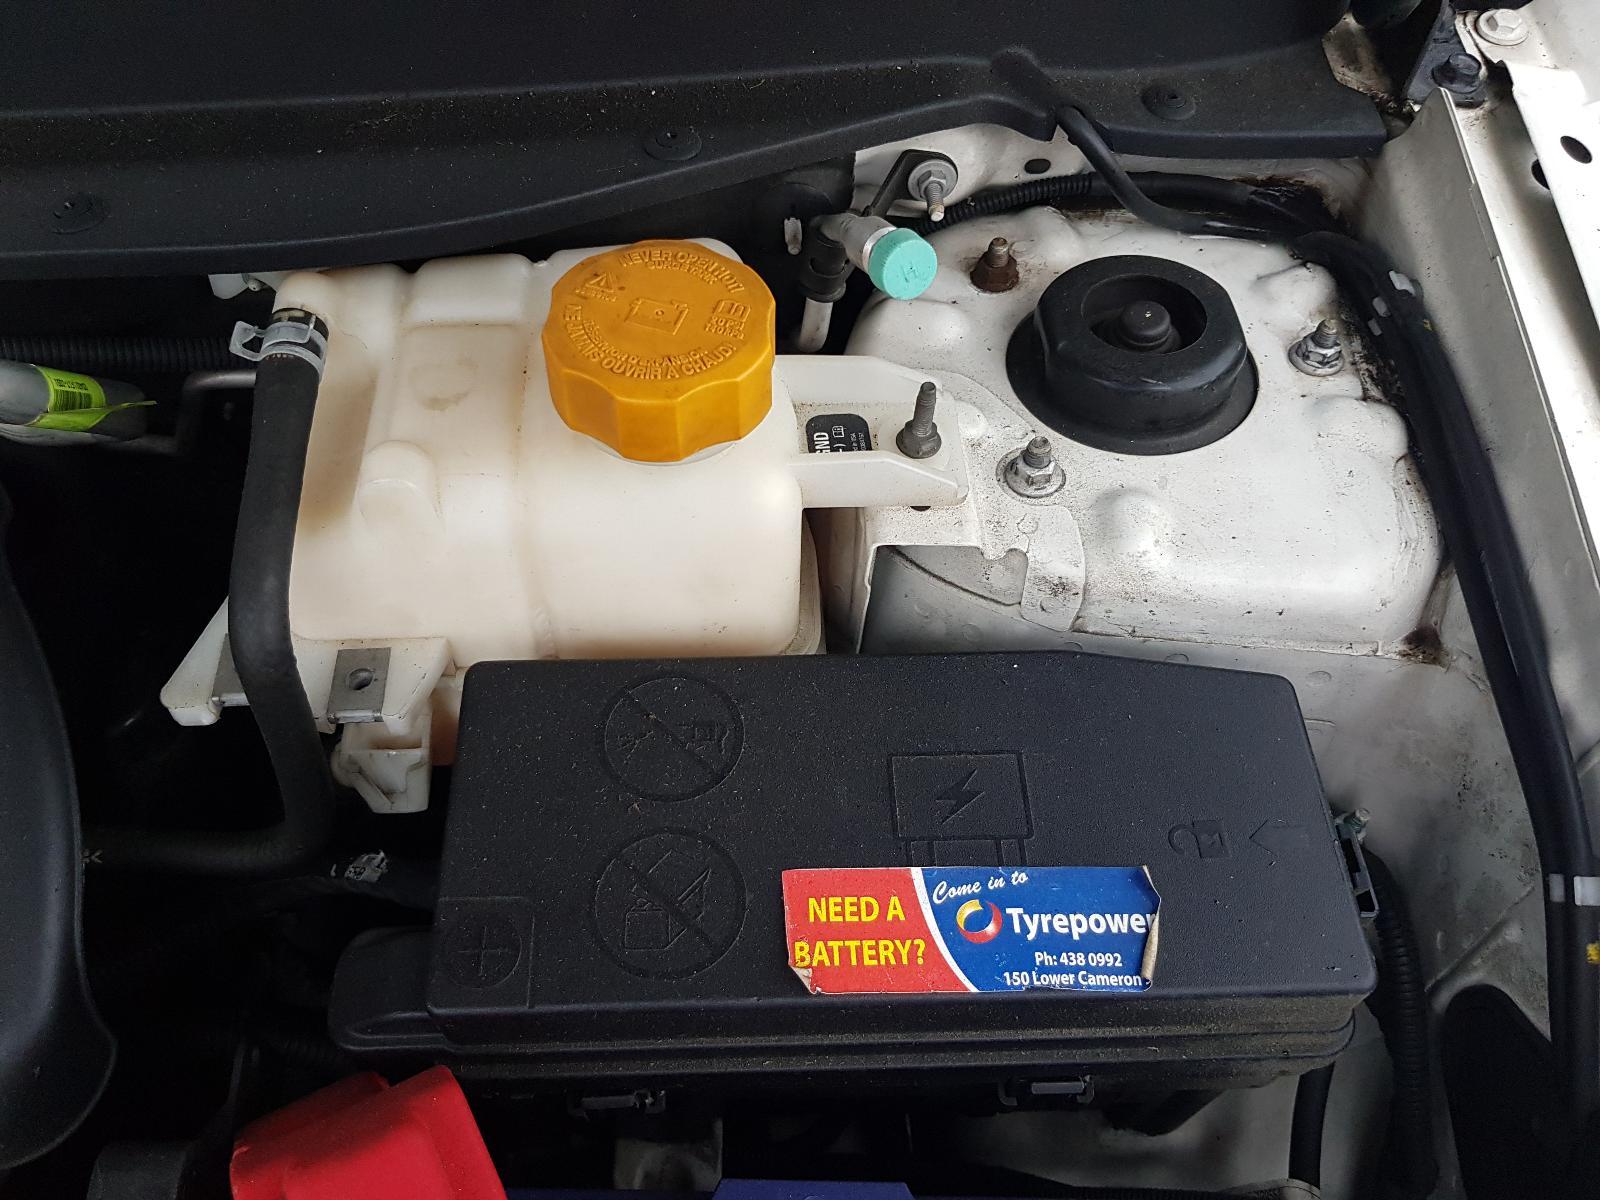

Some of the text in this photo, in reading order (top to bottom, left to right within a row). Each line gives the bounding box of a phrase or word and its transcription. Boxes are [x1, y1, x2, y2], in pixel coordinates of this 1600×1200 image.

[620, 249, 673, 267] NEVER
[675, 251, 719, 274] OPEN
[601, 357, 663, 380] OUVRIR
[932, 870, 1029, 904] Come in to
[808, 896, 906, 922] NEED A
[794, 938, 926, 968] BATTERY?
[1034, 951, 1123, 967] Ph: 438 0992
[1003, 971, 1030, 986] 150
[1032, 970, 1076, 986] Lower
[1078, 970, 1143, 986] Cameron
